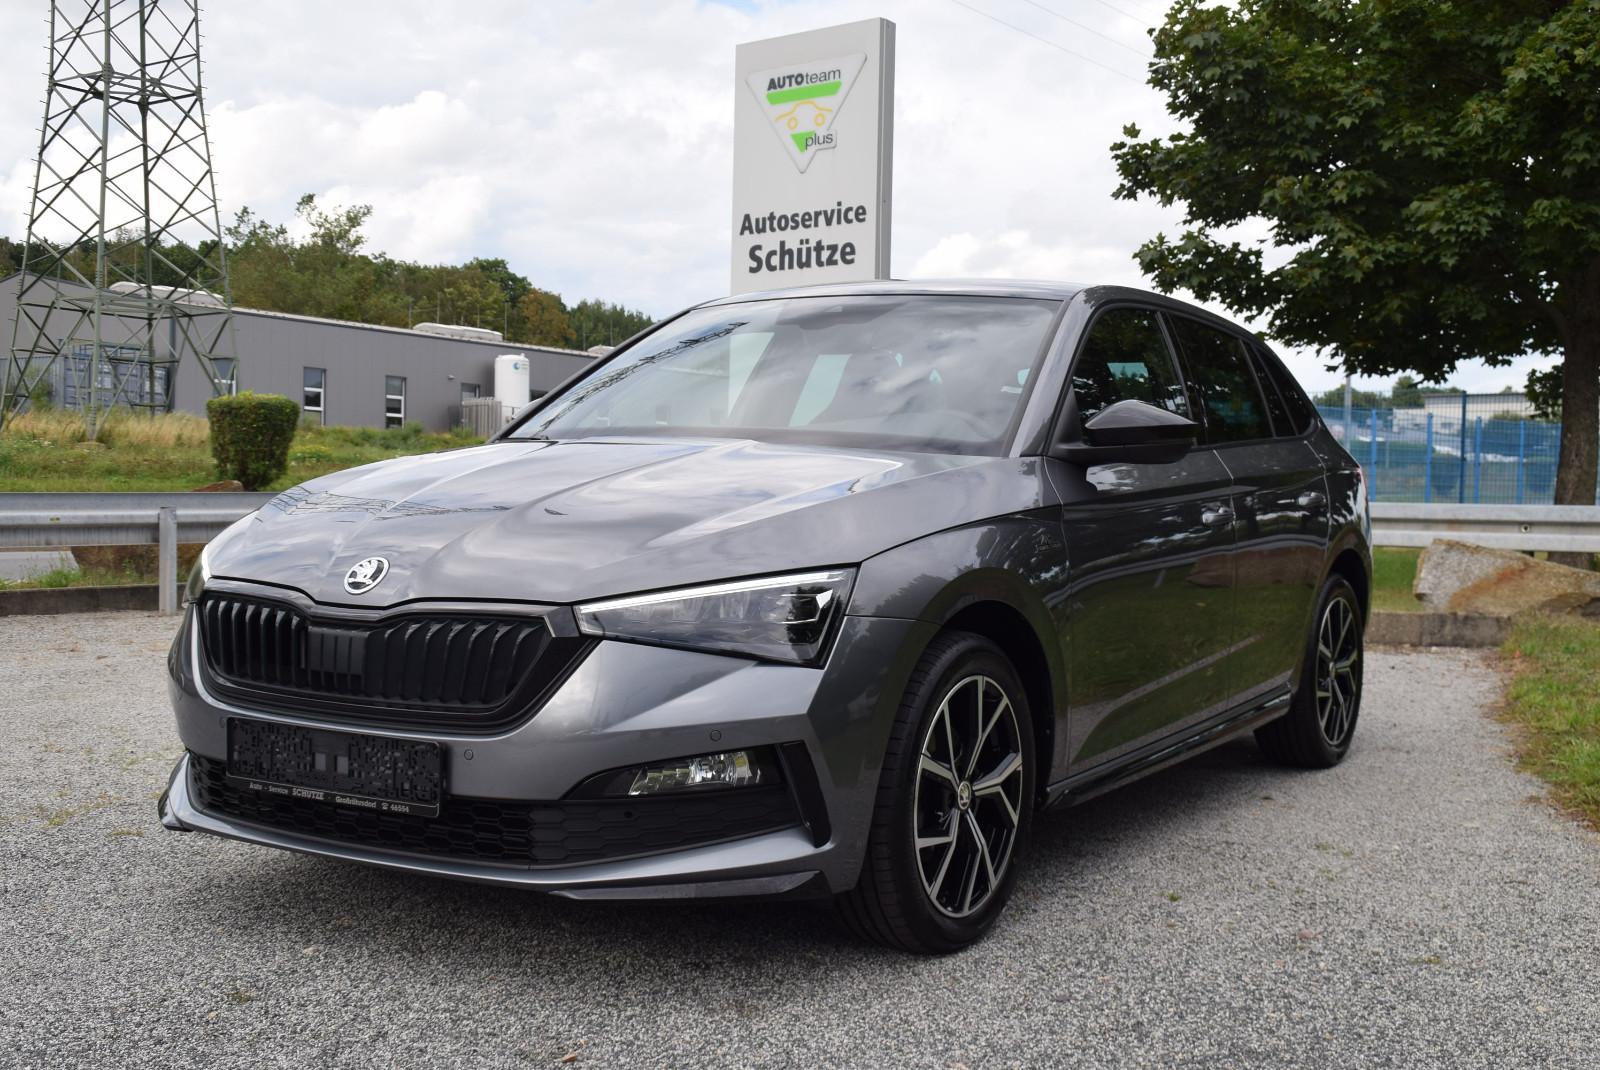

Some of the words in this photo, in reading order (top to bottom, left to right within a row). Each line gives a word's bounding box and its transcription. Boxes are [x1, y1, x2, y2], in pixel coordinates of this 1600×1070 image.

[767, 69, 841, 91] AUTOteam
[805, 132, 834, 151] plus
[739, 201, 867, 236] Autoservice
[748, 238, 856, 274] Schütze
